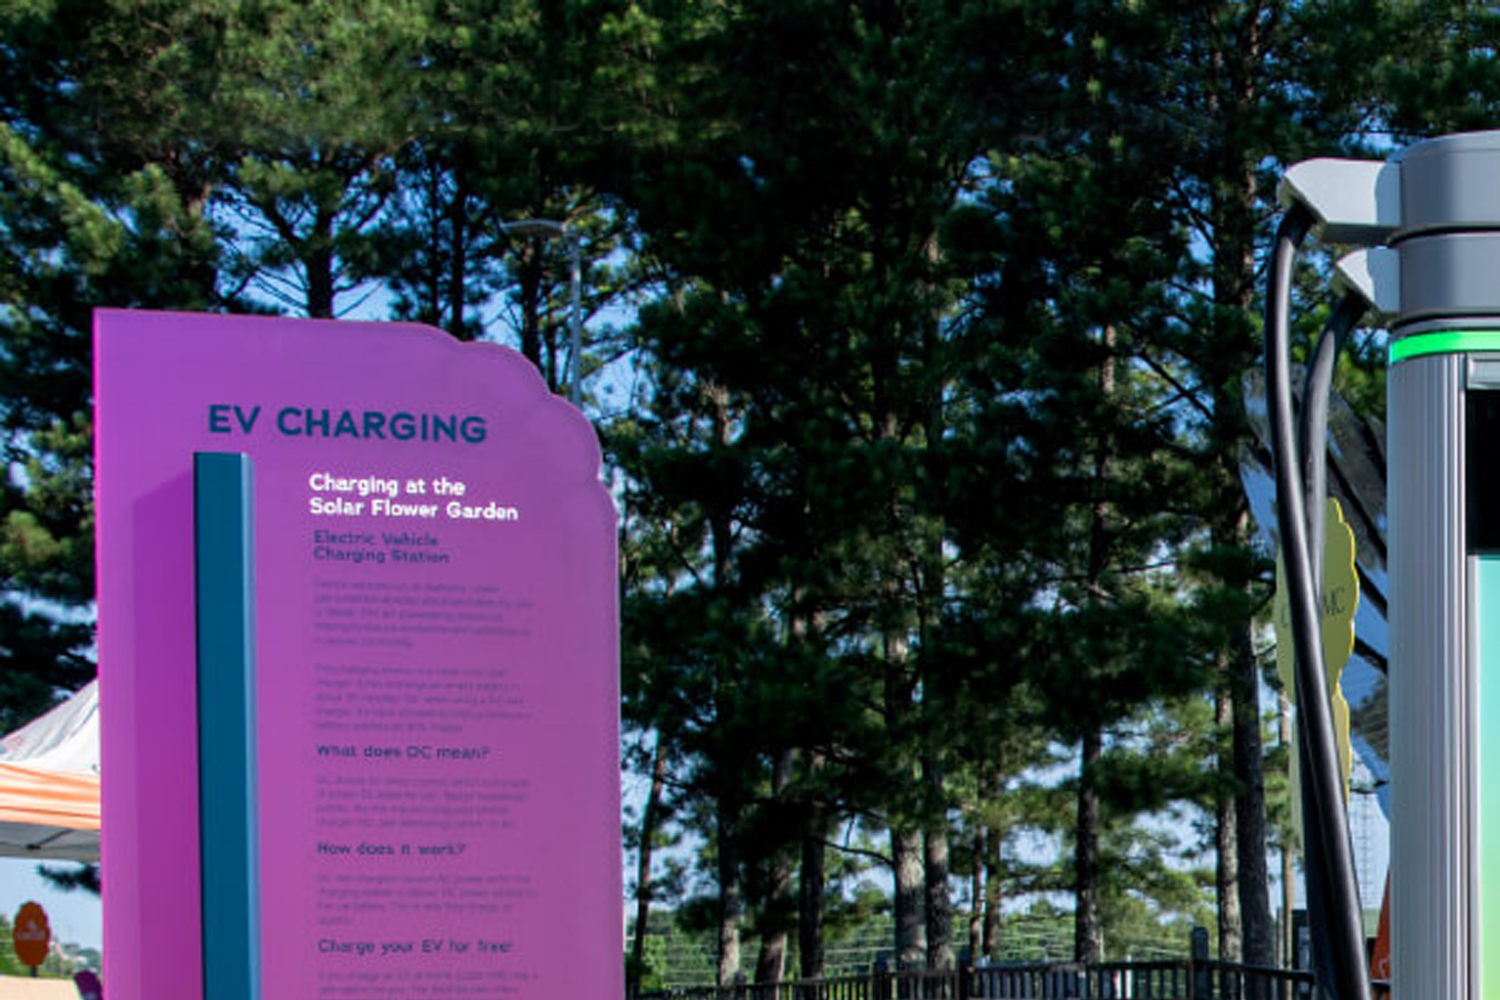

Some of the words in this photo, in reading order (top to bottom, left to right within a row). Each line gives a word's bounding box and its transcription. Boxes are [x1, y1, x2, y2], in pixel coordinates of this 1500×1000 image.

[208, 405, 261, 434] EV
[276, 407, 488, 443] CHARGING
[309, 473, 399, 496] Charging
[405, 478, 427, 494] at
[432, 477, 466, 495] the
[309, 497, 364, 516] Solar
[370, 499, 438, 517] Flower
[446, 502, 519, 521] Garden
[313, 529, 376, 545] Electric
[381, 531, 438, 547] Vehicle
[313, 546, 386, 564] Charging
[390, 548, 450, 564] Station
[316, 744, 358, 758] What
[362, 745, 402, 758] does
[436, 746, 491, 760] mean?
[316, 842, 352, 856] How
[356, 842, 395, 856] does
[317, 938, 376, 955] Charge
[381, 943, 413, 956] your
[420, 939, 443, 954] EV
[448, 938, 471, 954] for
